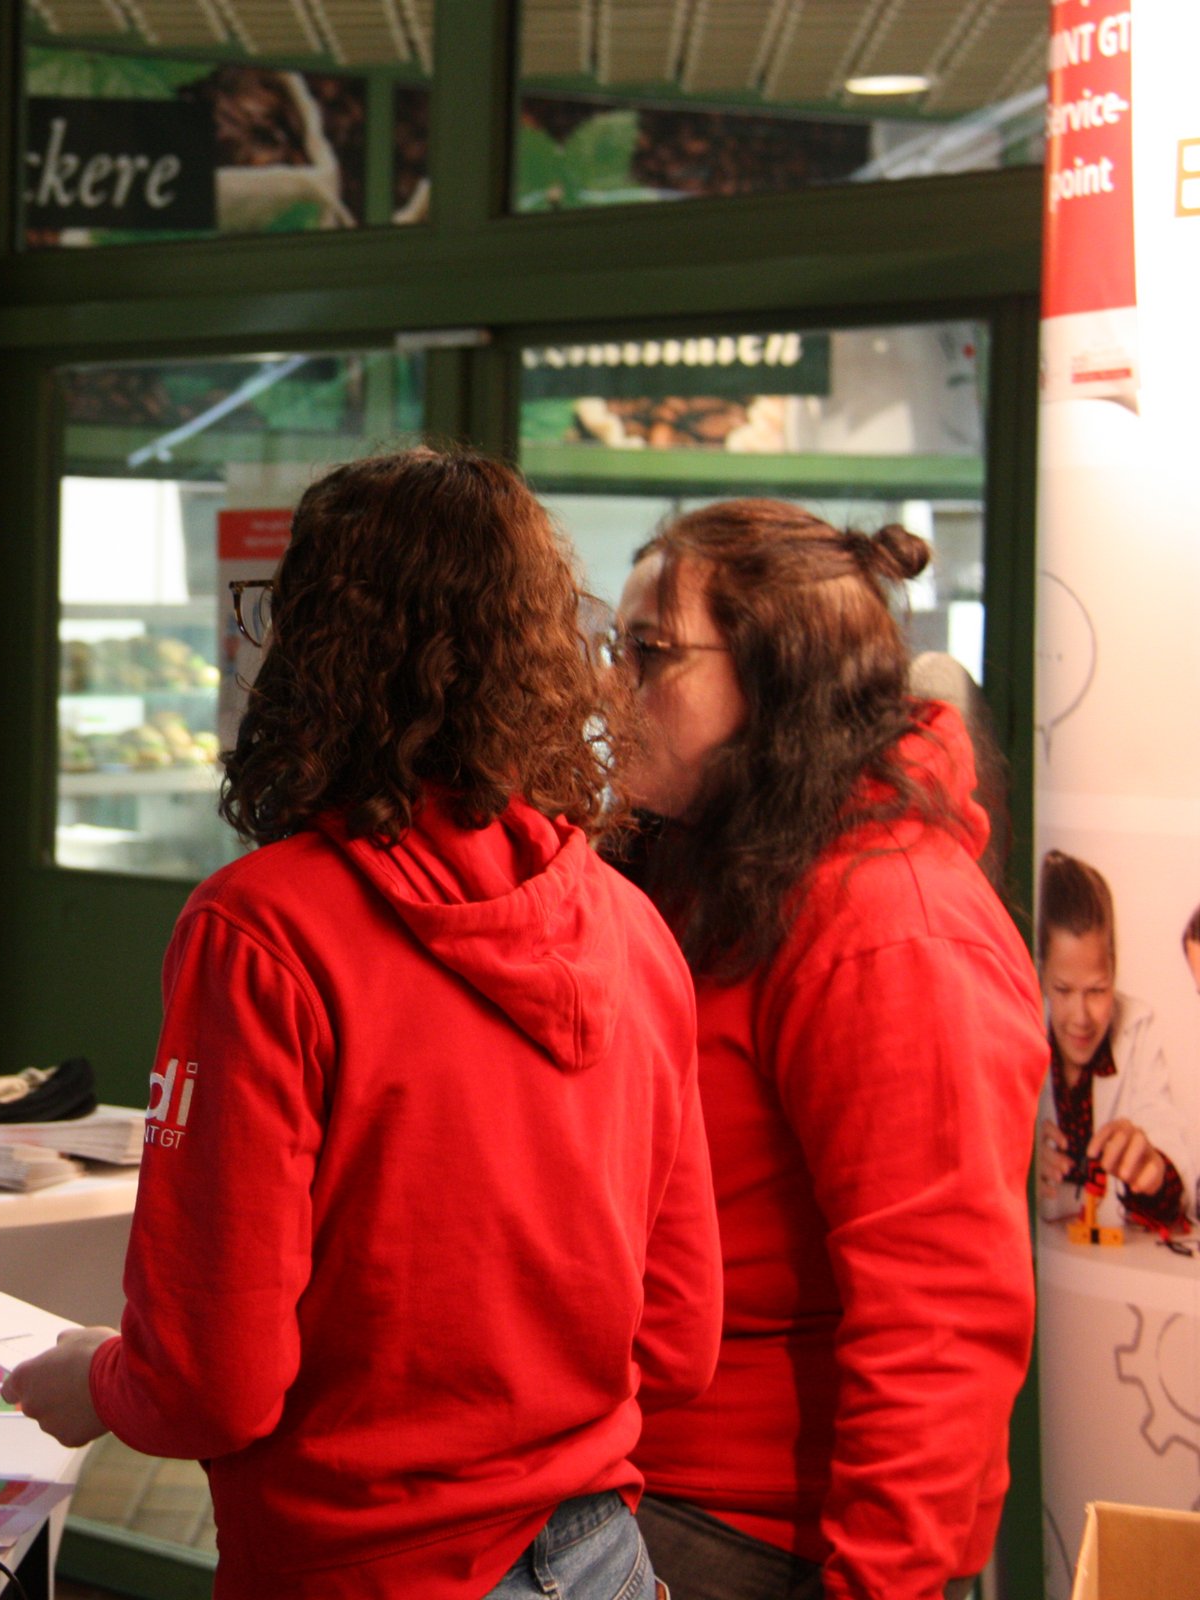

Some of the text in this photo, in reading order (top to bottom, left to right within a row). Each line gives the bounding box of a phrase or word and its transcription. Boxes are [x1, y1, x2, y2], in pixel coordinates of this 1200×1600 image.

[1098, 12, 1131, 57] GT
[1047, 88, 1129, 138] ervice-
[1049, 157, 1114, 214] point
[160, 1128, 186, 1149] GT
